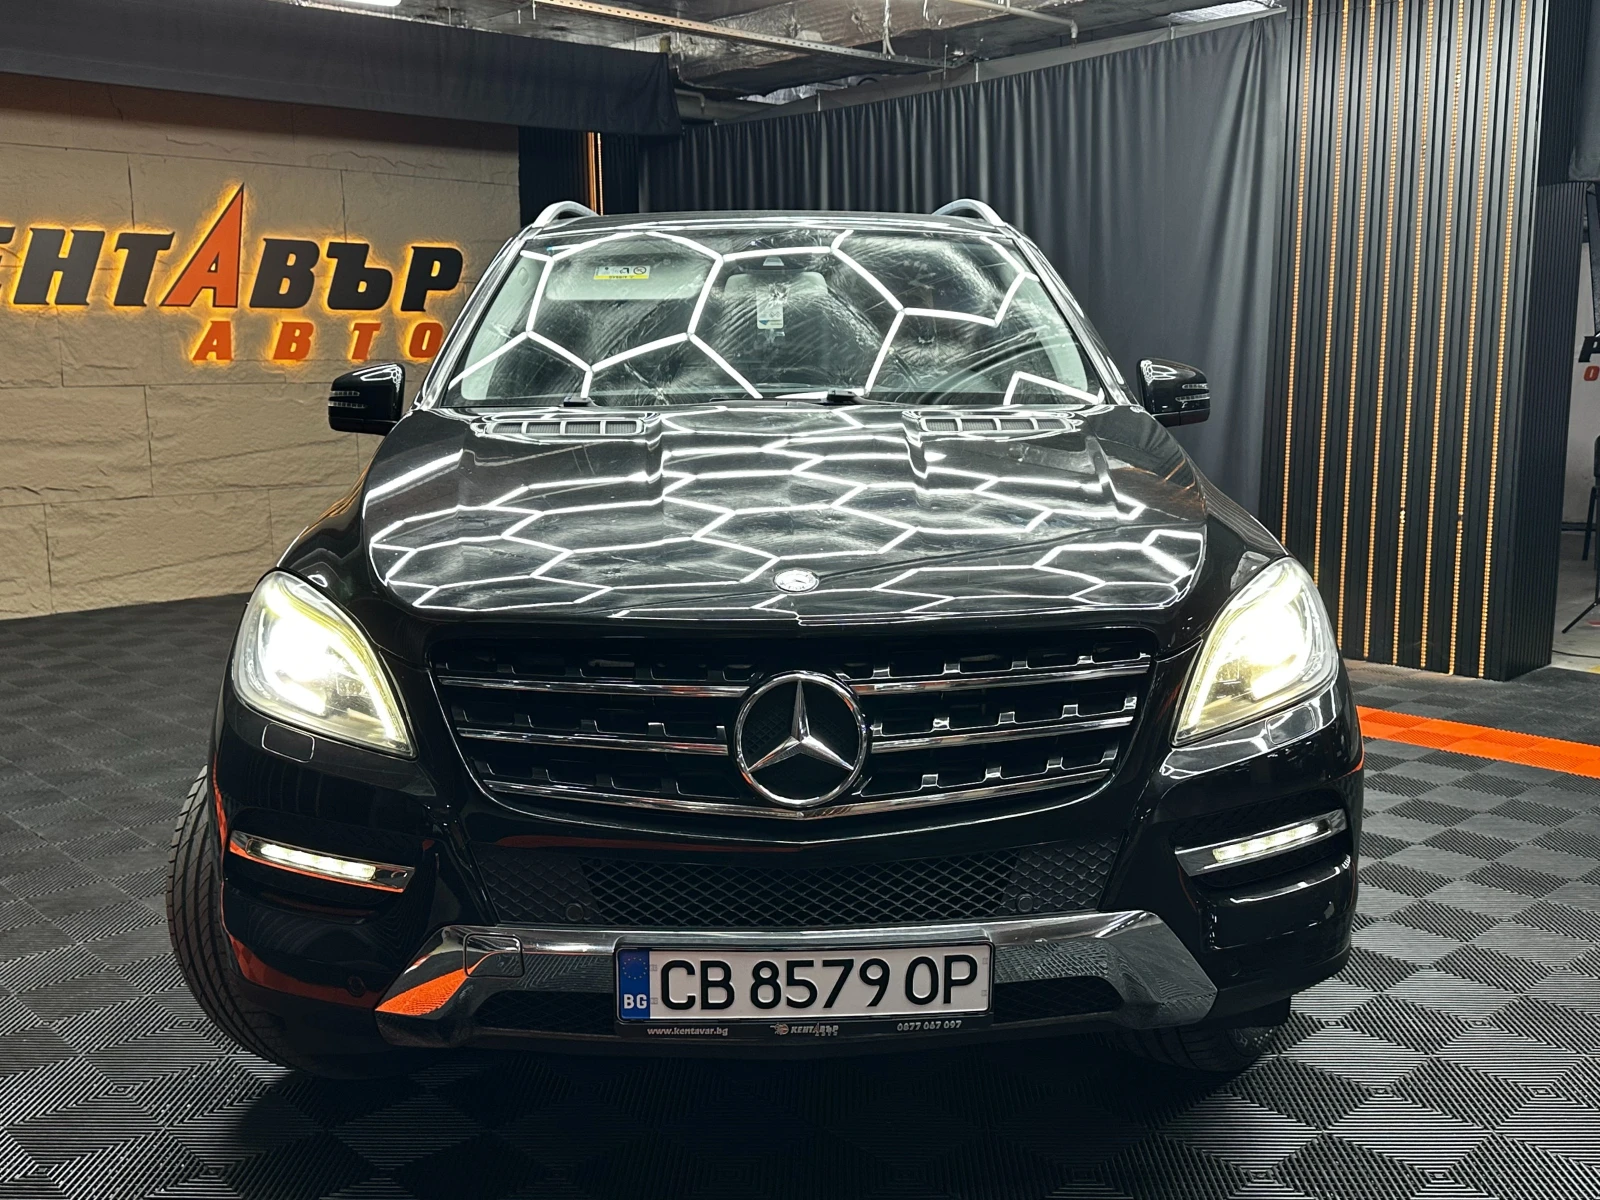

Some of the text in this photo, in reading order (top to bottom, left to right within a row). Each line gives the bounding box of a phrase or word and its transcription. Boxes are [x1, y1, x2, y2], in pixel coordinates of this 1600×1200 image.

[0, 183, 464, 312] НТАВЪР
[193, 320, 444, 361] АВТО
[661, 959, 735, 1010] CB
[750, 958, 890, 1010] 8579
[623, 993, 648, 1009] BG
[647, 1026, 729, 1036] www.kentavar.bg
[896, 1021, 922, 1031] 0877
[943, 1019, 962, 1029] 097
